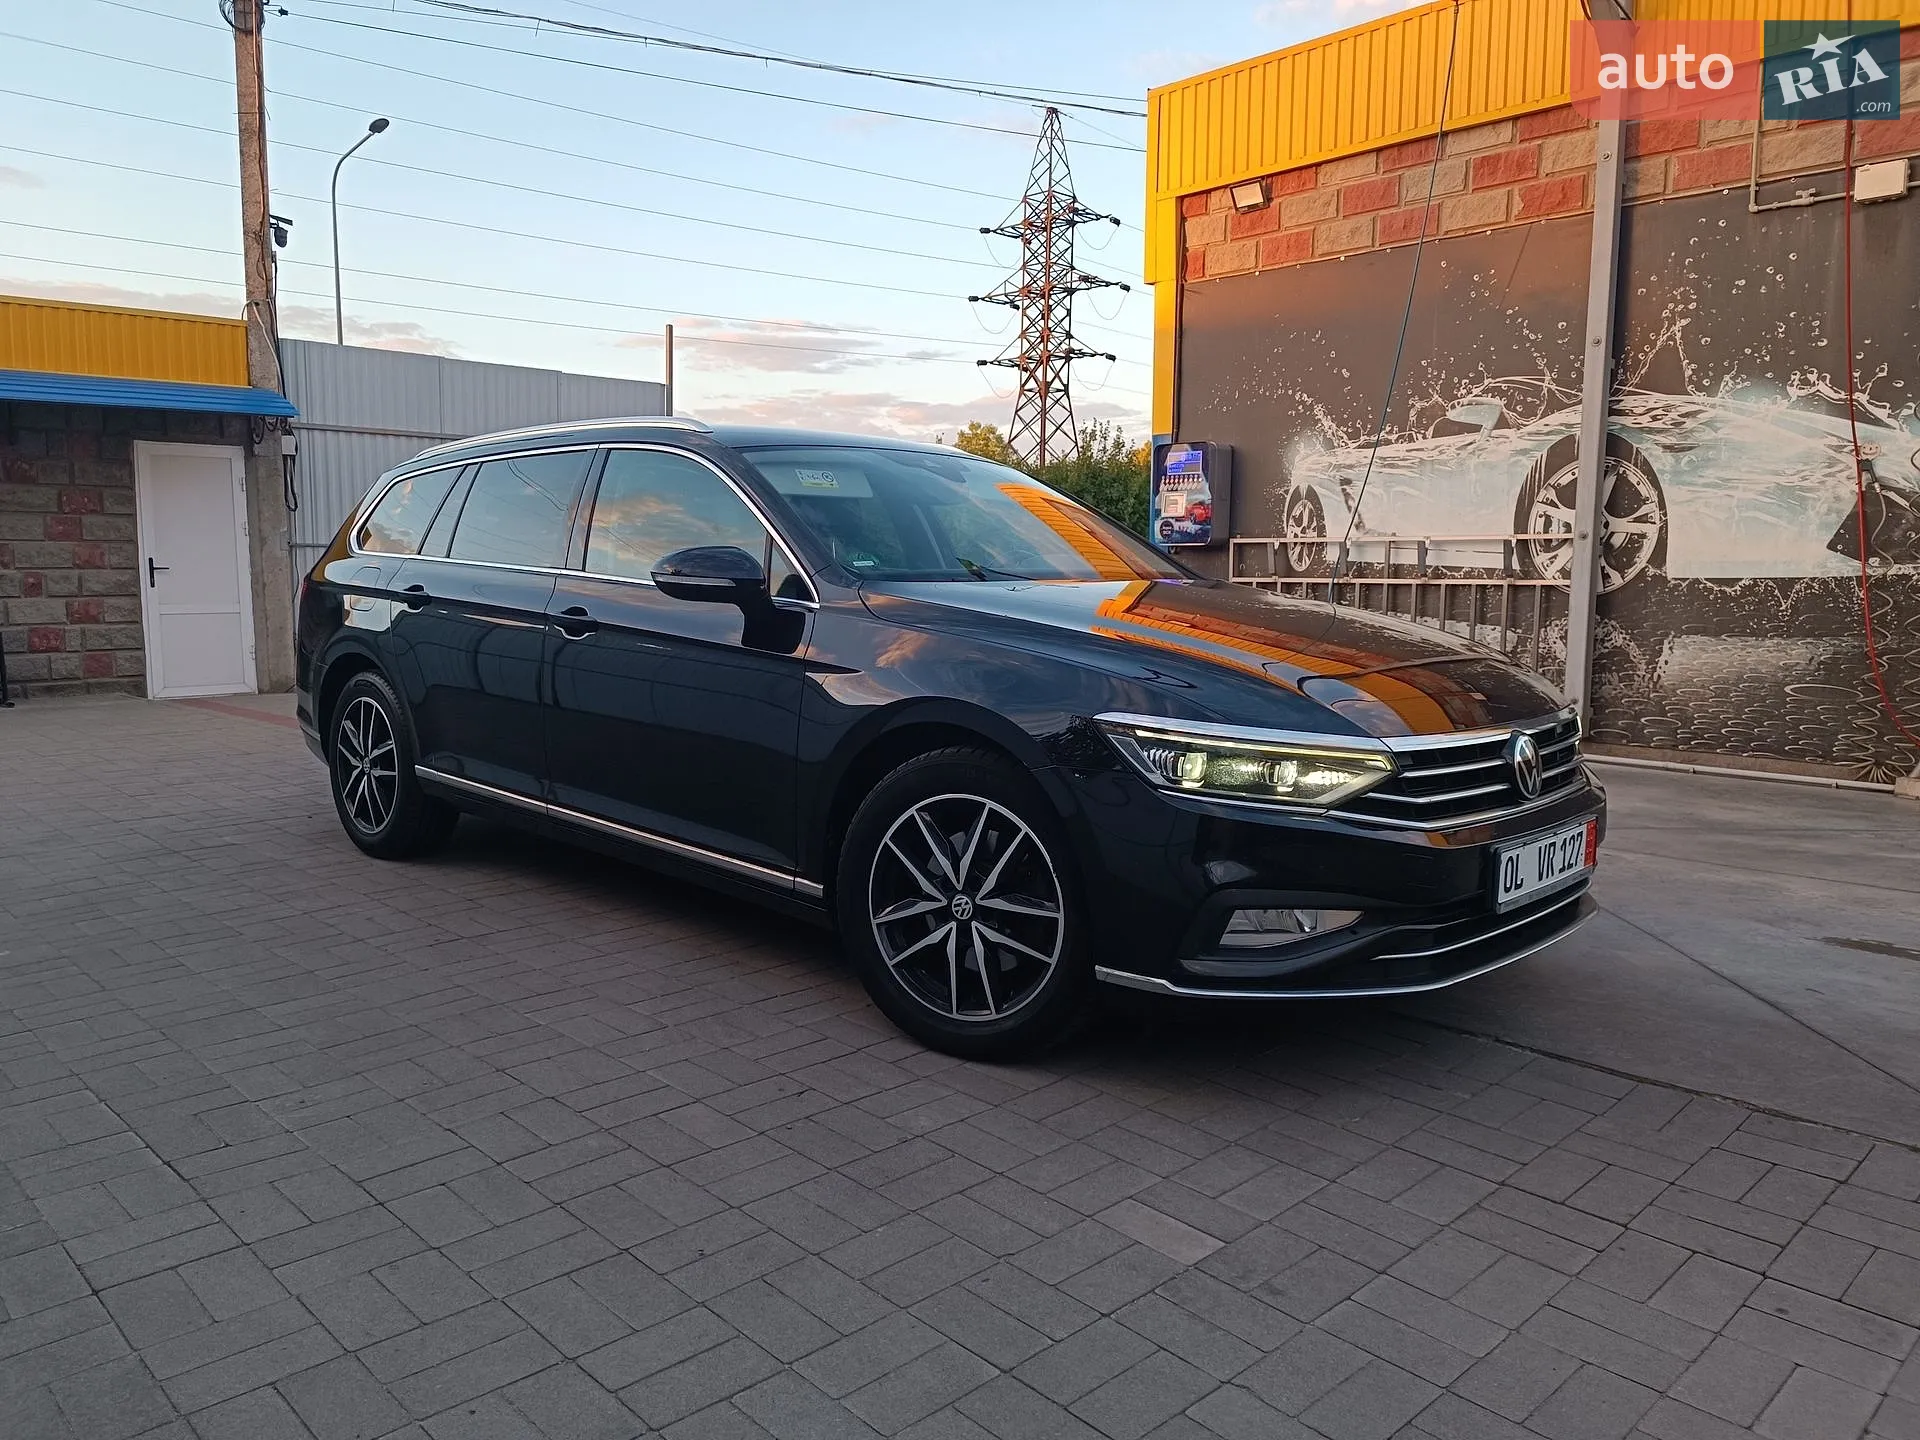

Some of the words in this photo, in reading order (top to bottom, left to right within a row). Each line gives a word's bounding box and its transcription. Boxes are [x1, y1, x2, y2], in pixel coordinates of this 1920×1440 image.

[1503, 853, 1524, 893] OL
[1538, 840, 1557, 882] VR
[1558, 830, 1584, 874] 127
